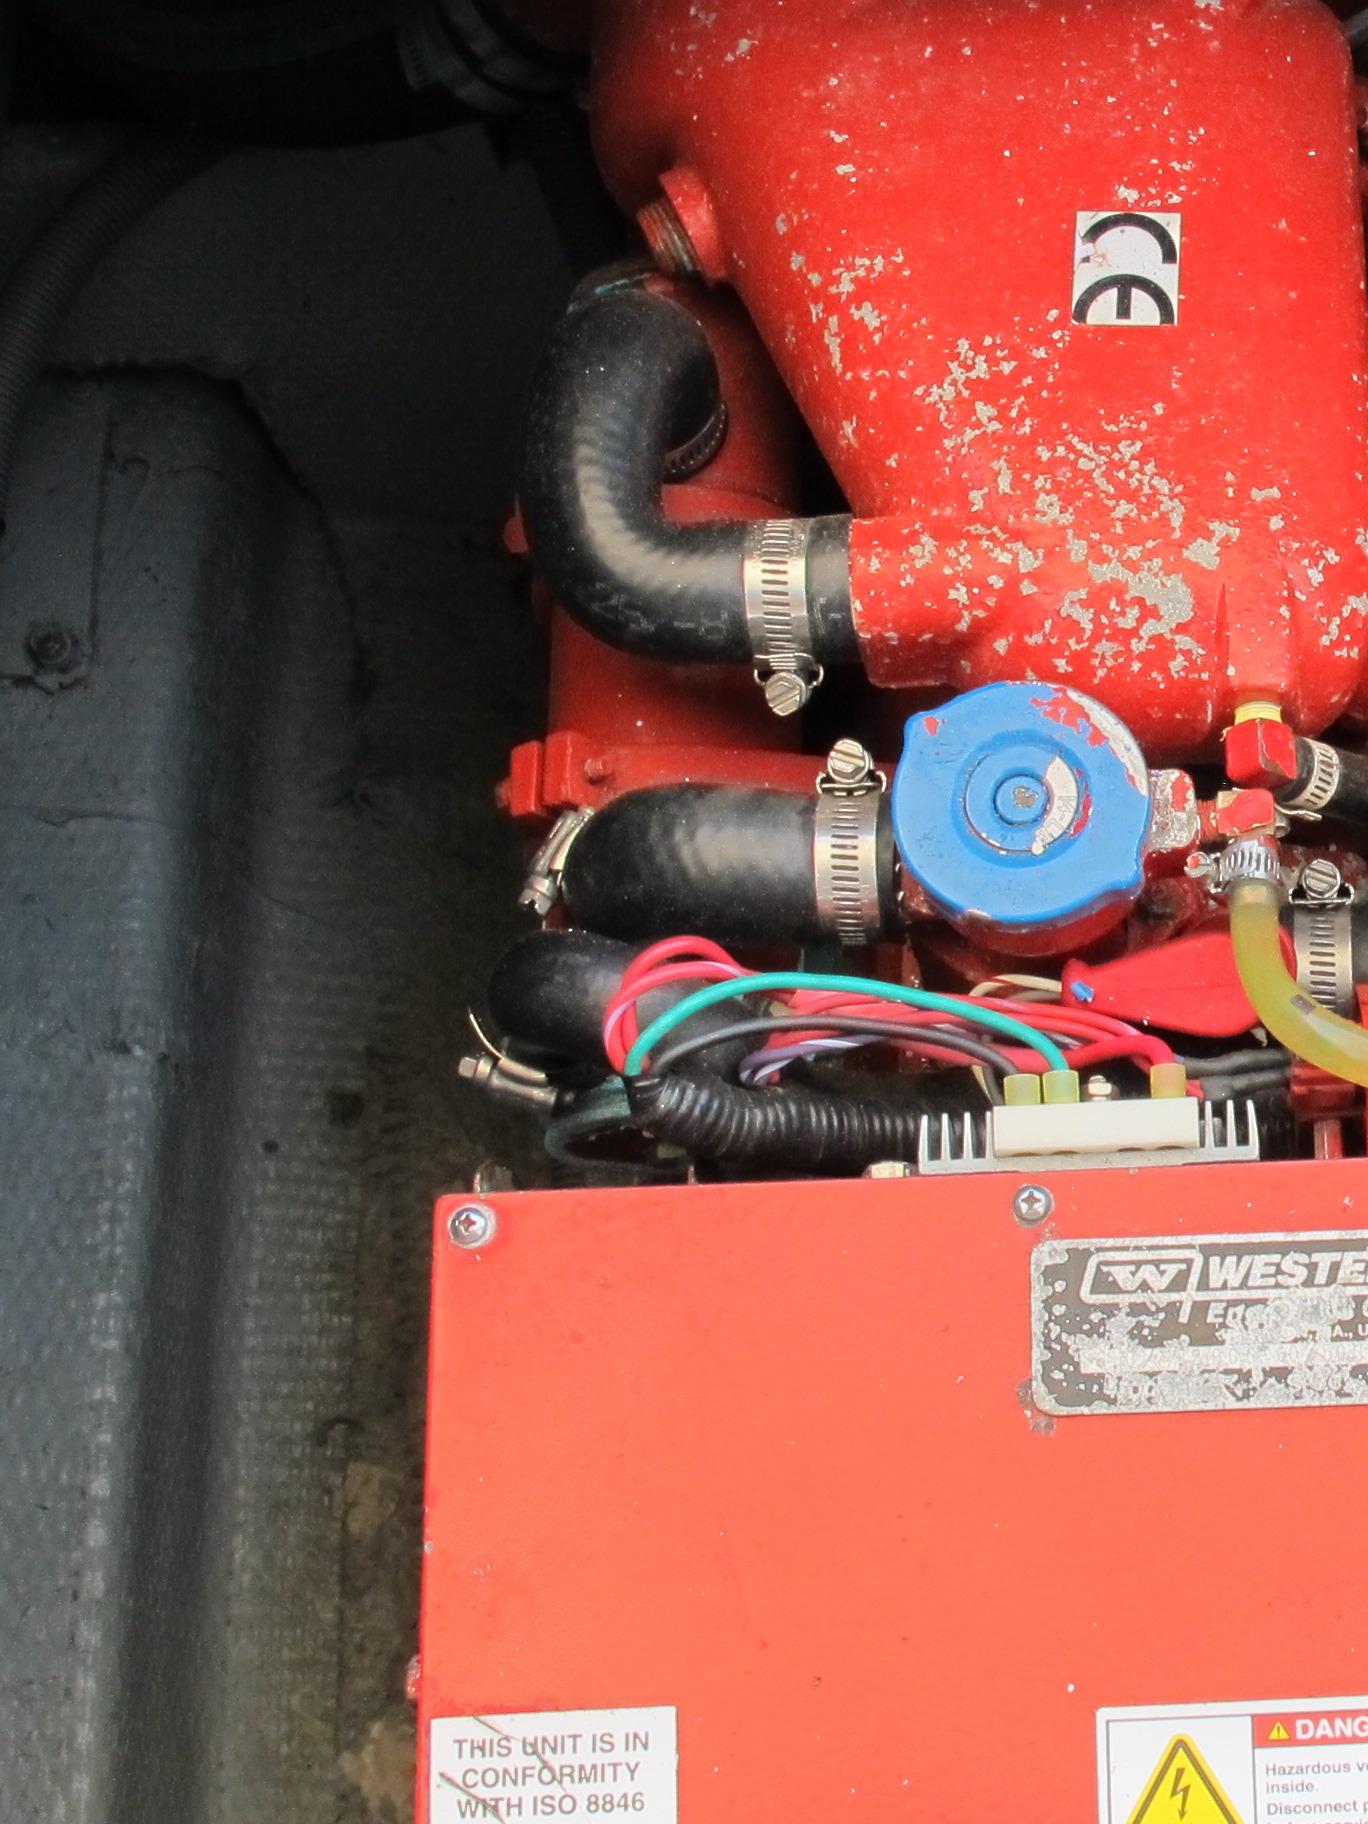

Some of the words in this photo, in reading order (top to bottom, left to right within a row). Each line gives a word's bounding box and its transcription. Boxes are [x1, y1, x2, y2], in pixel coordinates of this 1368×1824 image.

[453, 1736, 512, 1759] THIS
[522, 1733, 582, 1756] UNIT
[591, 1733, 615, 1753] IS
[624, 1731, 649, 1751] IN
[462, 1761, 641, 1789] CONFORMITY
[1265, 1760, 1352, 1777] Hazardous
[1265, 1779, 1320, 1794] inside.
[456, 1796, 523, 1819] WITH
[532, 1795, 576, 1816] ISO
[586, 1792, 645, 1814] 8846
[1266, 1799, 1358, 1816] Disconnect
